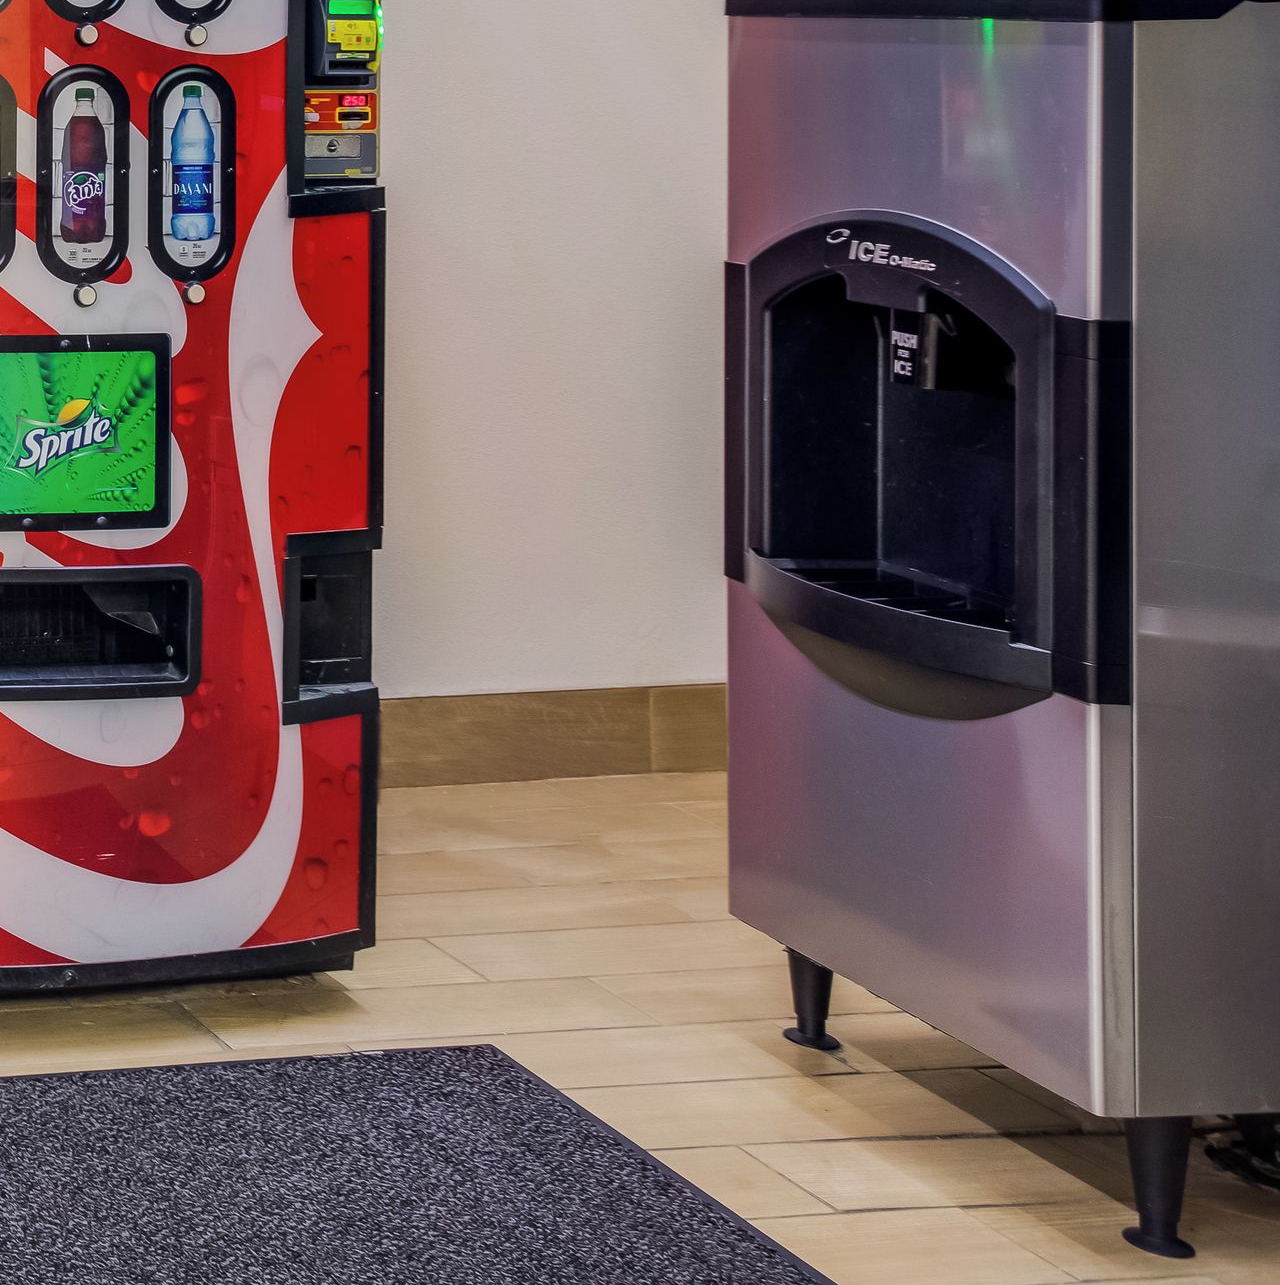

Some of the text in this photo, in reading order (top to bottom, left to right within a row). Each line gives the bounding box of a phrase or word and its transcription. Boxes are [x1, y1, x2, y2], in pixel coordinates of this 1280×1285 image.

[64, 177, 104, 207] Fanta
[173, 182, 213, 196] DASANI
[847, 239, 891, 266] ICE
[891, 330, 919, 350] PUSH
[893, 359, 913, 377] ICE
[17, 410, 113, 474] Sprite
